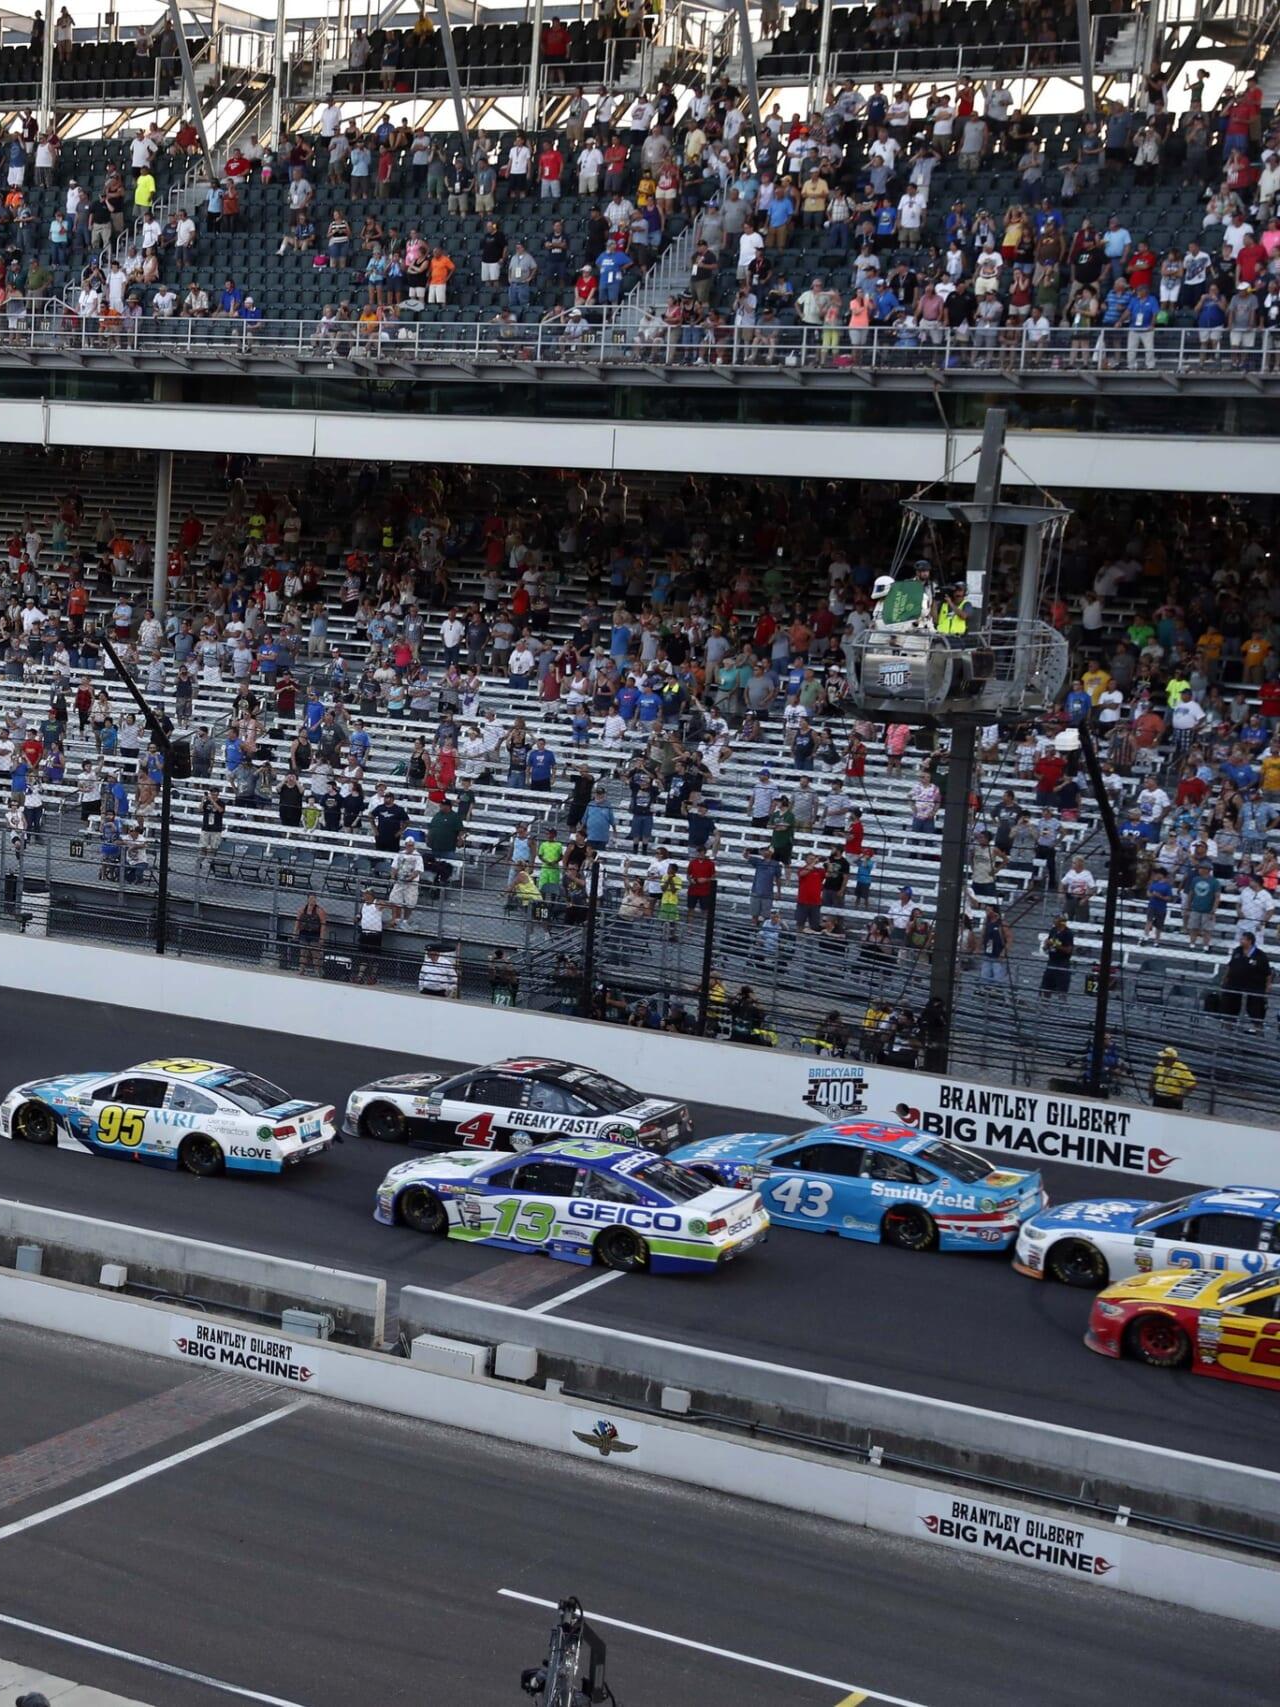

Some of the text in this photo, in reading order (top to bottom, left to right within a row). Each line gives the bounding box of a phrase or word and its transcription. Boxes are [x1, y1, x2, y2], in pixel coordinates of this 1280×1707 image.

[883, 672, 904, 686] 400
[808, 1068, 864, 1078] BRICKYARD
[816, 1081, 855, 1106] 400
[98, 1105, 149, 1148] 95
[151, 1109, 201, 1130] WRL
[507, 1110, 559, 1131] FREAKY
[558, 1117, 600, 1136] FAST!
[939, 1085, 1131, 1136] BRANTLEY GILBERT
[455, 1112, 497, 1149] 4
[922, 1111, 1145, 1170] BIG MACHINE
[230, 1145, 272, 1159] K-LOVE
[610, 1150, 660, 1175] GEICO
[770, 1177, 833, 1218] 43
[871, 1182, 976, 1210] Smithfield
[494, 1198, 557, 1243] 13
[568, 1200, 682, 1232] GEICO
[727, 1217, 752, 1236] GEICO
[980, 1228, 1001, 1243] STP
[196, 1325, 293, 1361] BRANTLEY GILBERT
[188, 1340, 299, 1381] BIG MACHINE
[951, 1501, 1084, 1549] BRANTLEY GILBERT
[939, 1518, 1094, 1574] BIG MACHINE
